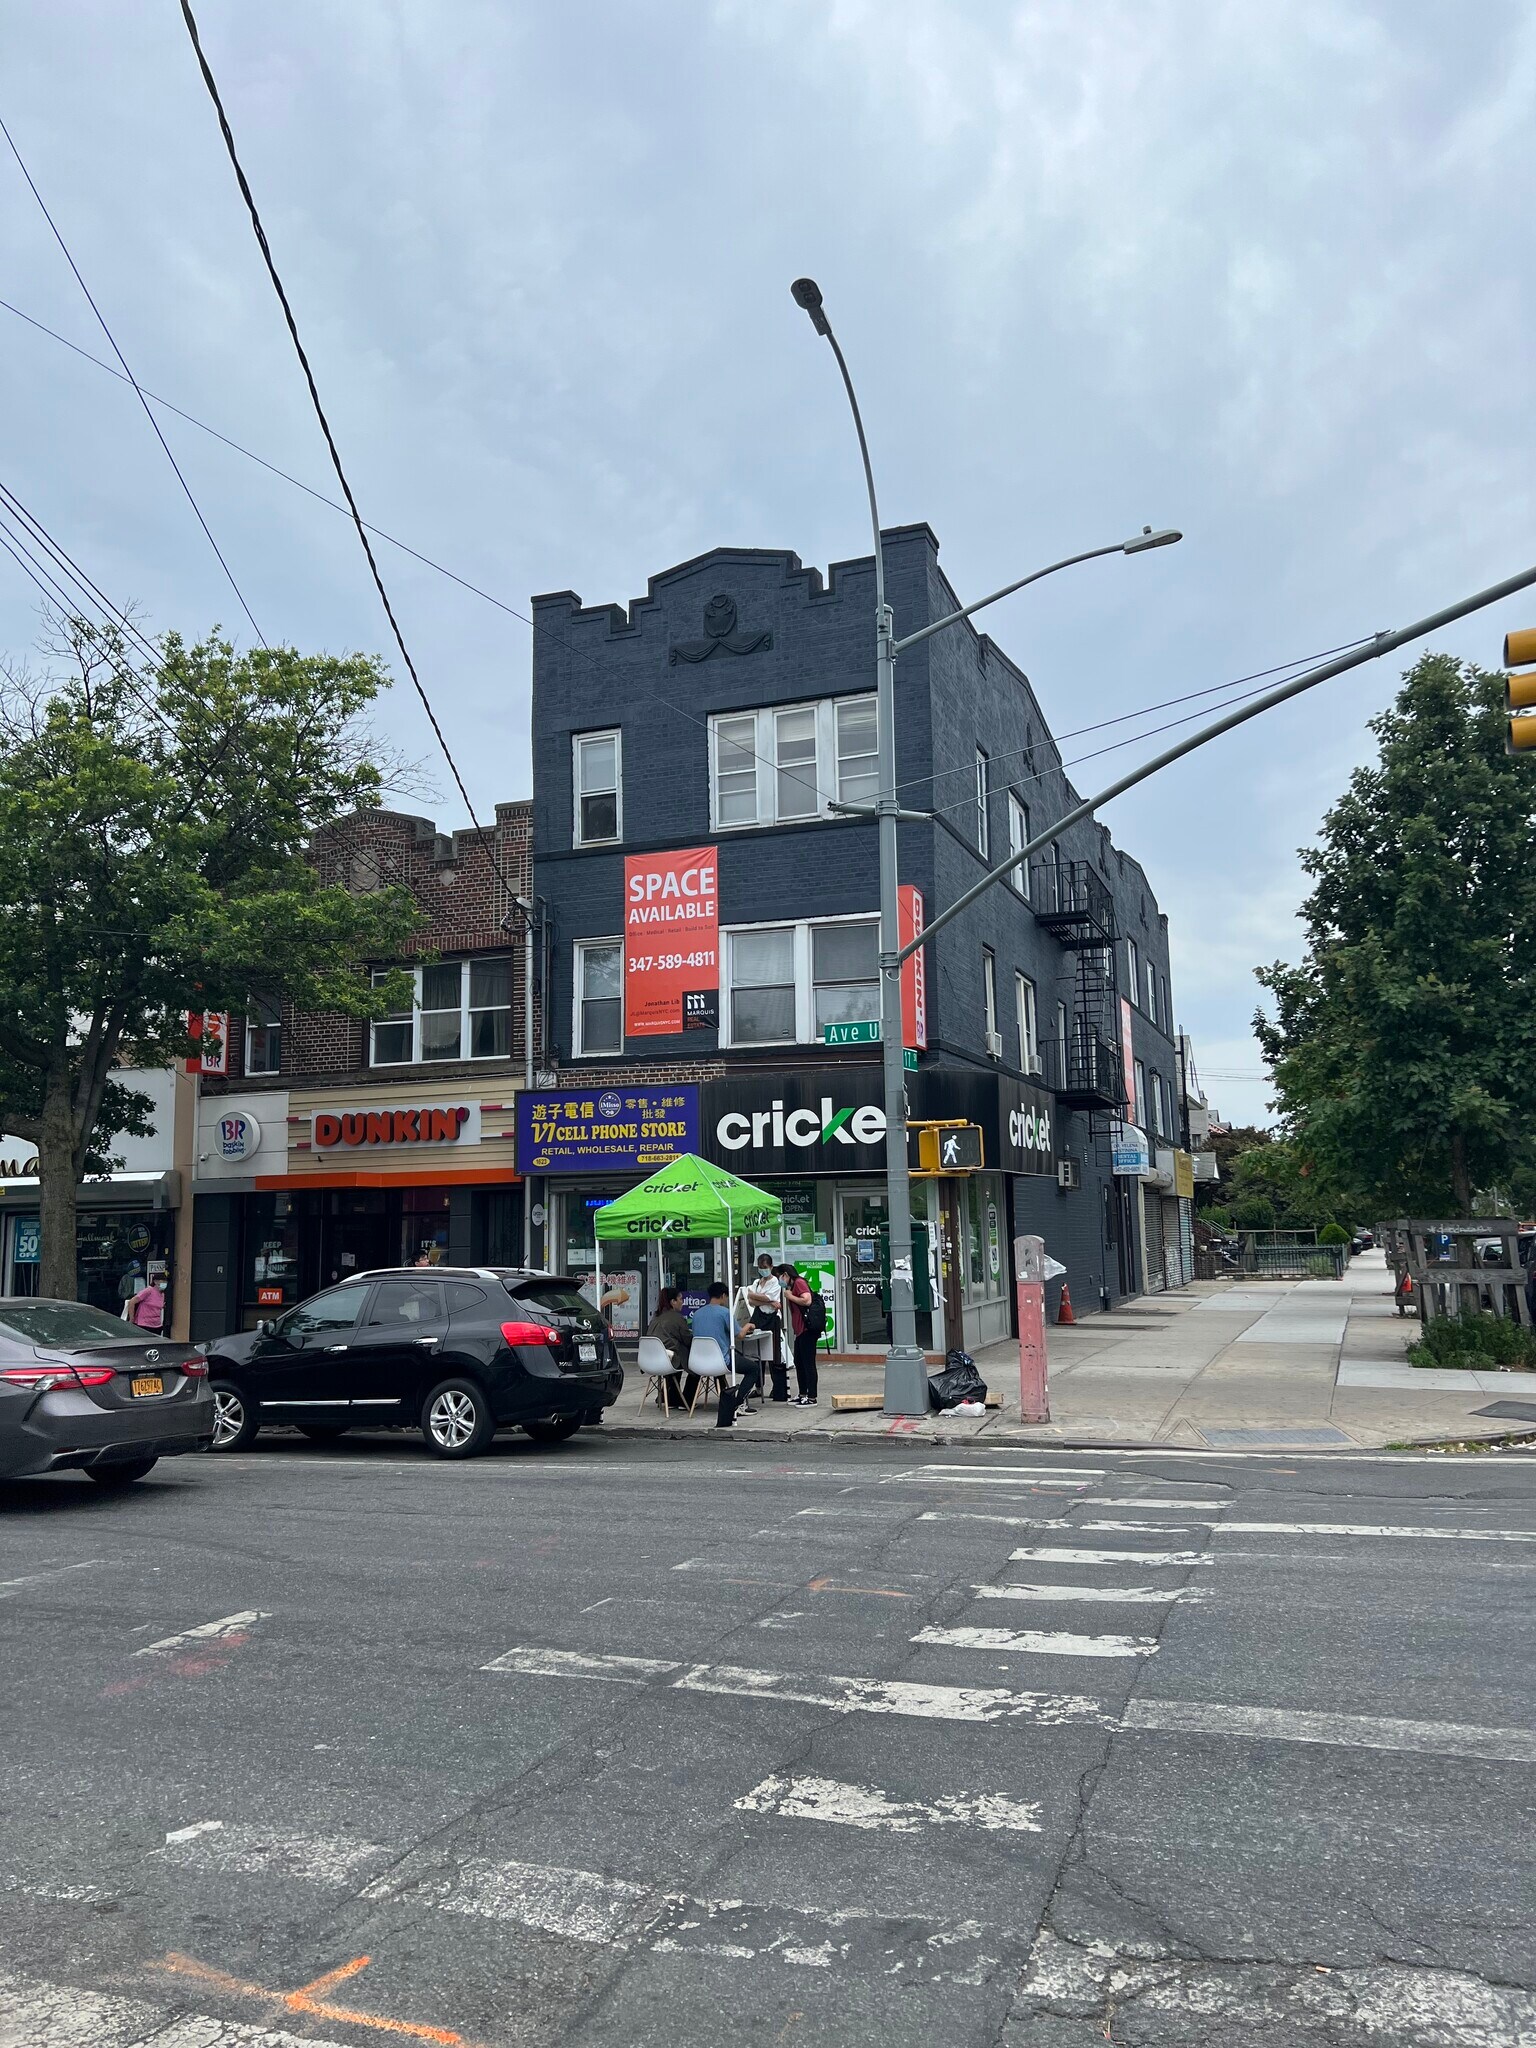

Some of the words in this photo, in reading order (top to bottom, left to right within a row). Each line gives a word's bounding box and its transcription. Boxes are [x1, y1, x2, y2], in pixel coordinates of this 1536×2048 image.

[629, 867, 715, 902] SPACE
[628, 900, 715, 924] AVAILABLE
[628, 950, 715, 973] 347-589-4811
[914, 897, 923, 1016] DUKIN'
[829, 1026, 859, 1042] Ave
[869, 1023, 878, 1040] U
[221, 1120, 246, 1141] BR
[315, 1106, 470, 1146] DUNKIN'
[556, 1125, 589, 1142] CELL
[592, 1123, 638, 1140] PHONE
[641, 1121, 687, 1138] STORE
[717, 1097, 909, 1150] cricke
[1009, 1102, 1051, 1152] cricket
[541, 1147, 575, 1156] RETAIL,
[577, 1144, 638, 1154] WHOLESALE,
[640, 1143, 674, 1152] REPAIR
[643, 1181, 699, 1194] cricket
[713, 1178, 738, 1189] cricket
[627, 1215, 691, 1234] cricket
[743, 1208, 770, 1228] cricket
[263, 1241, 282, 1249] KEEP
[420, 1240, 437, 1248] IT'S
[261, 1291, 280, 1301] ATM
